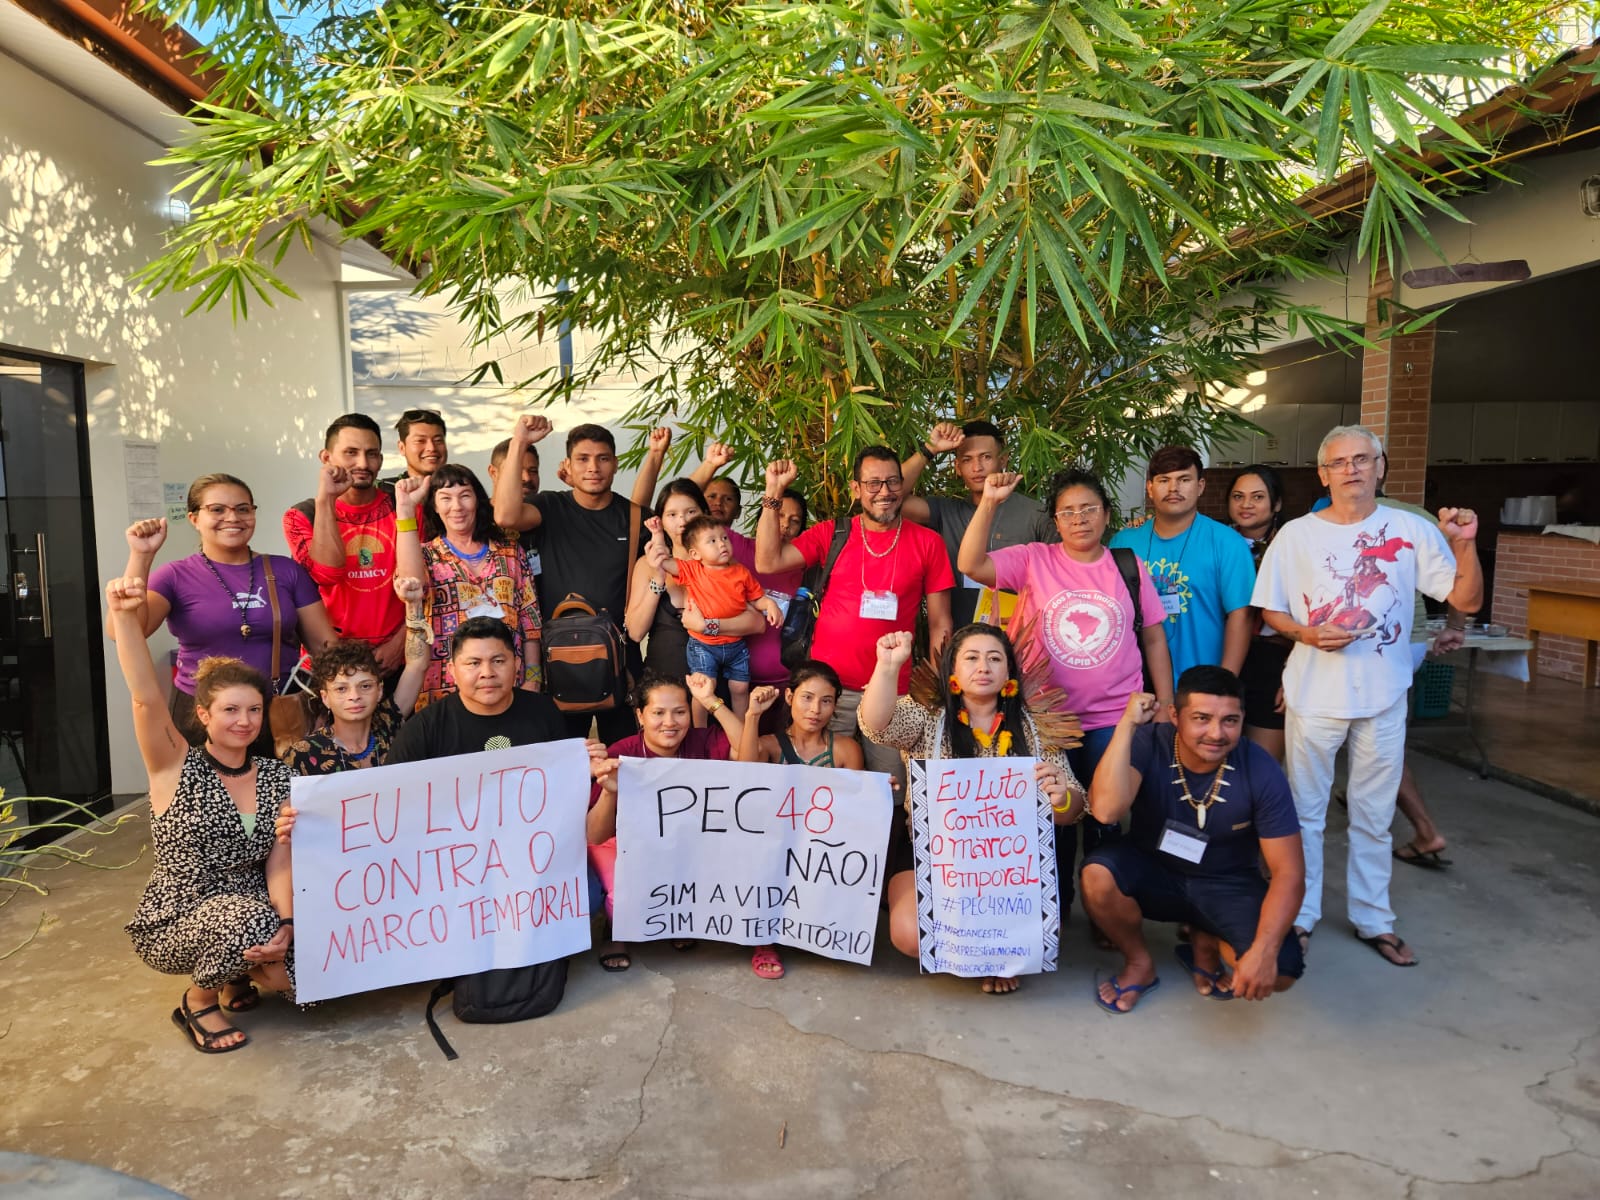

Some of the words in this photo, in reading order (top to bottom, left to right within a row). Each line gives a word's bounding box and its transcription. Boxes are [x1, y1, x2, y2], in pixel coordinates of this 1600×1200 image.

[347, 569, 387, 579] OLIMCV
[1051, 594, 1066, 609] dos
[1067, 657, 1091, 666] APIB
[341, 787, 401, 853] EU
[426, 765, 547, 834] LUTO
[943, 802, 1017, 832] Contra
[334, 838, 509, 912] CONTRA
[528, 831, 555, 875] O
[785, 838, 879, 896] NÃO!
[647, 881, 697, 910] SIM
[709, 883, 726, 904] A
[735, 884, 800, 910] VIDA
[941, 892, 1032, 916] #PEC48NÃO
[323, 904, 448, 972] MARCO
[458, 876, 590, 940] TEMPORAL
[643, 911, 694, 937] SIM
[704, 914, 733, 935] AO
[741, 917, 872, 956] TERRITÓRIO
